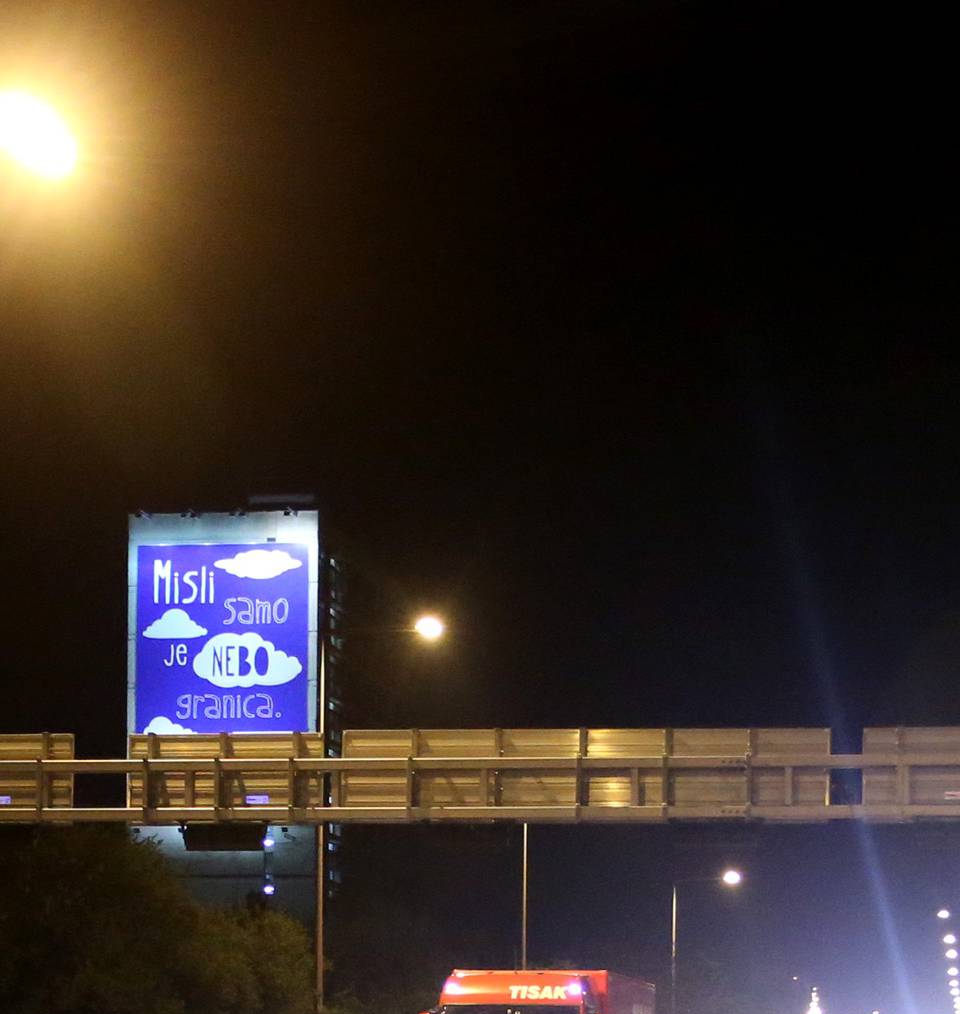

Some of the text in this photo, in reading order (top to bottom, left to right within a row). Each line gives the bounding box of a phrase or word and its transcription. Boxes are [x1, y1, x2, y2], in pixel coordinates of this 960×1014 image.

[153, 559, 215, 604] Misli
[223, 597, 289, 625] samo
[212, 645, 269, 677] NEBO
[176, 693, 282, 720] granica.
[509, 985, 568, 1000] TISAK
